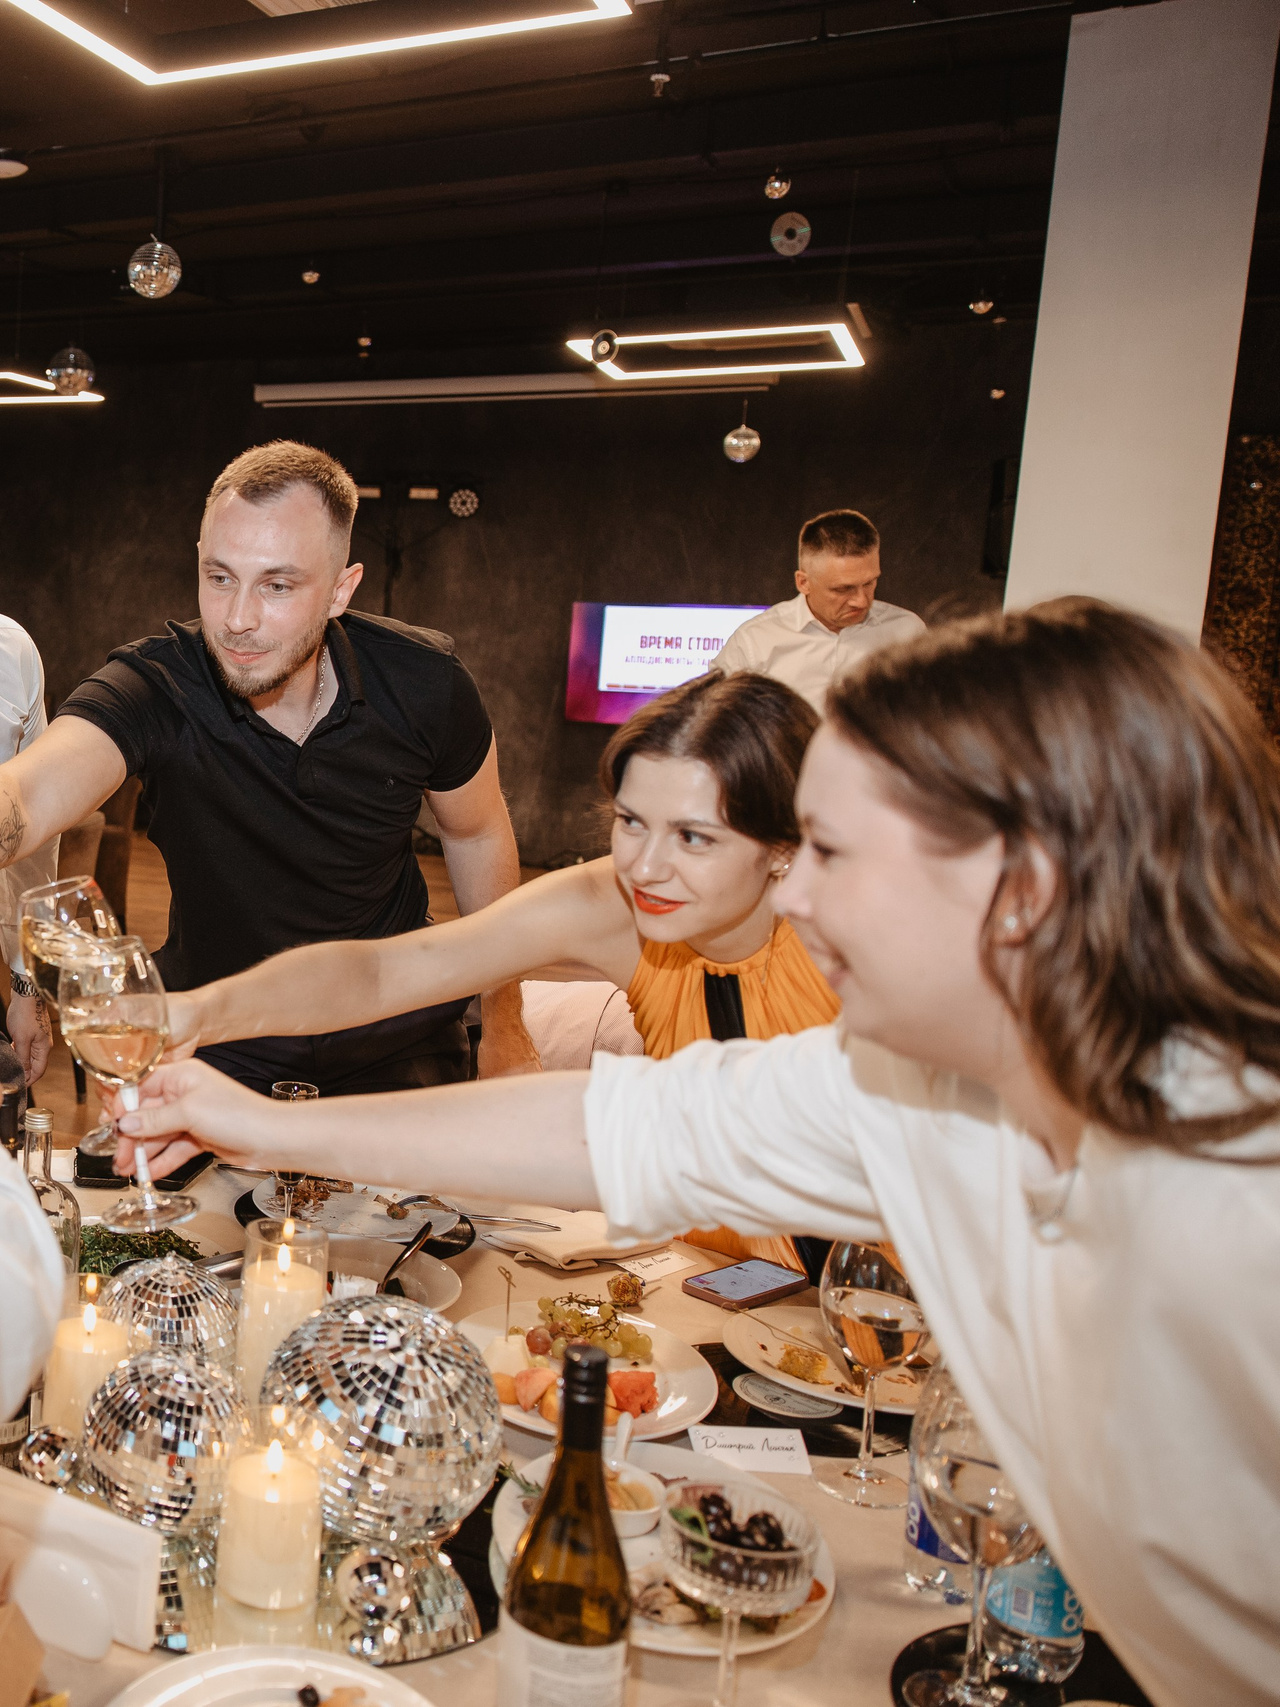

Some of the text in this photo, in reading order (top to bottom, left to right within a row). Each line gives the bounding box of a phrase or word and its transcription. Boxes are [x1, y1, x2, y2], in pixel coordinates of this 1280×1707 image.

[639, 635, 724, 651] ВРЕМЯ СТОП
[701, 1435, 755, 1453] Дмитрий
